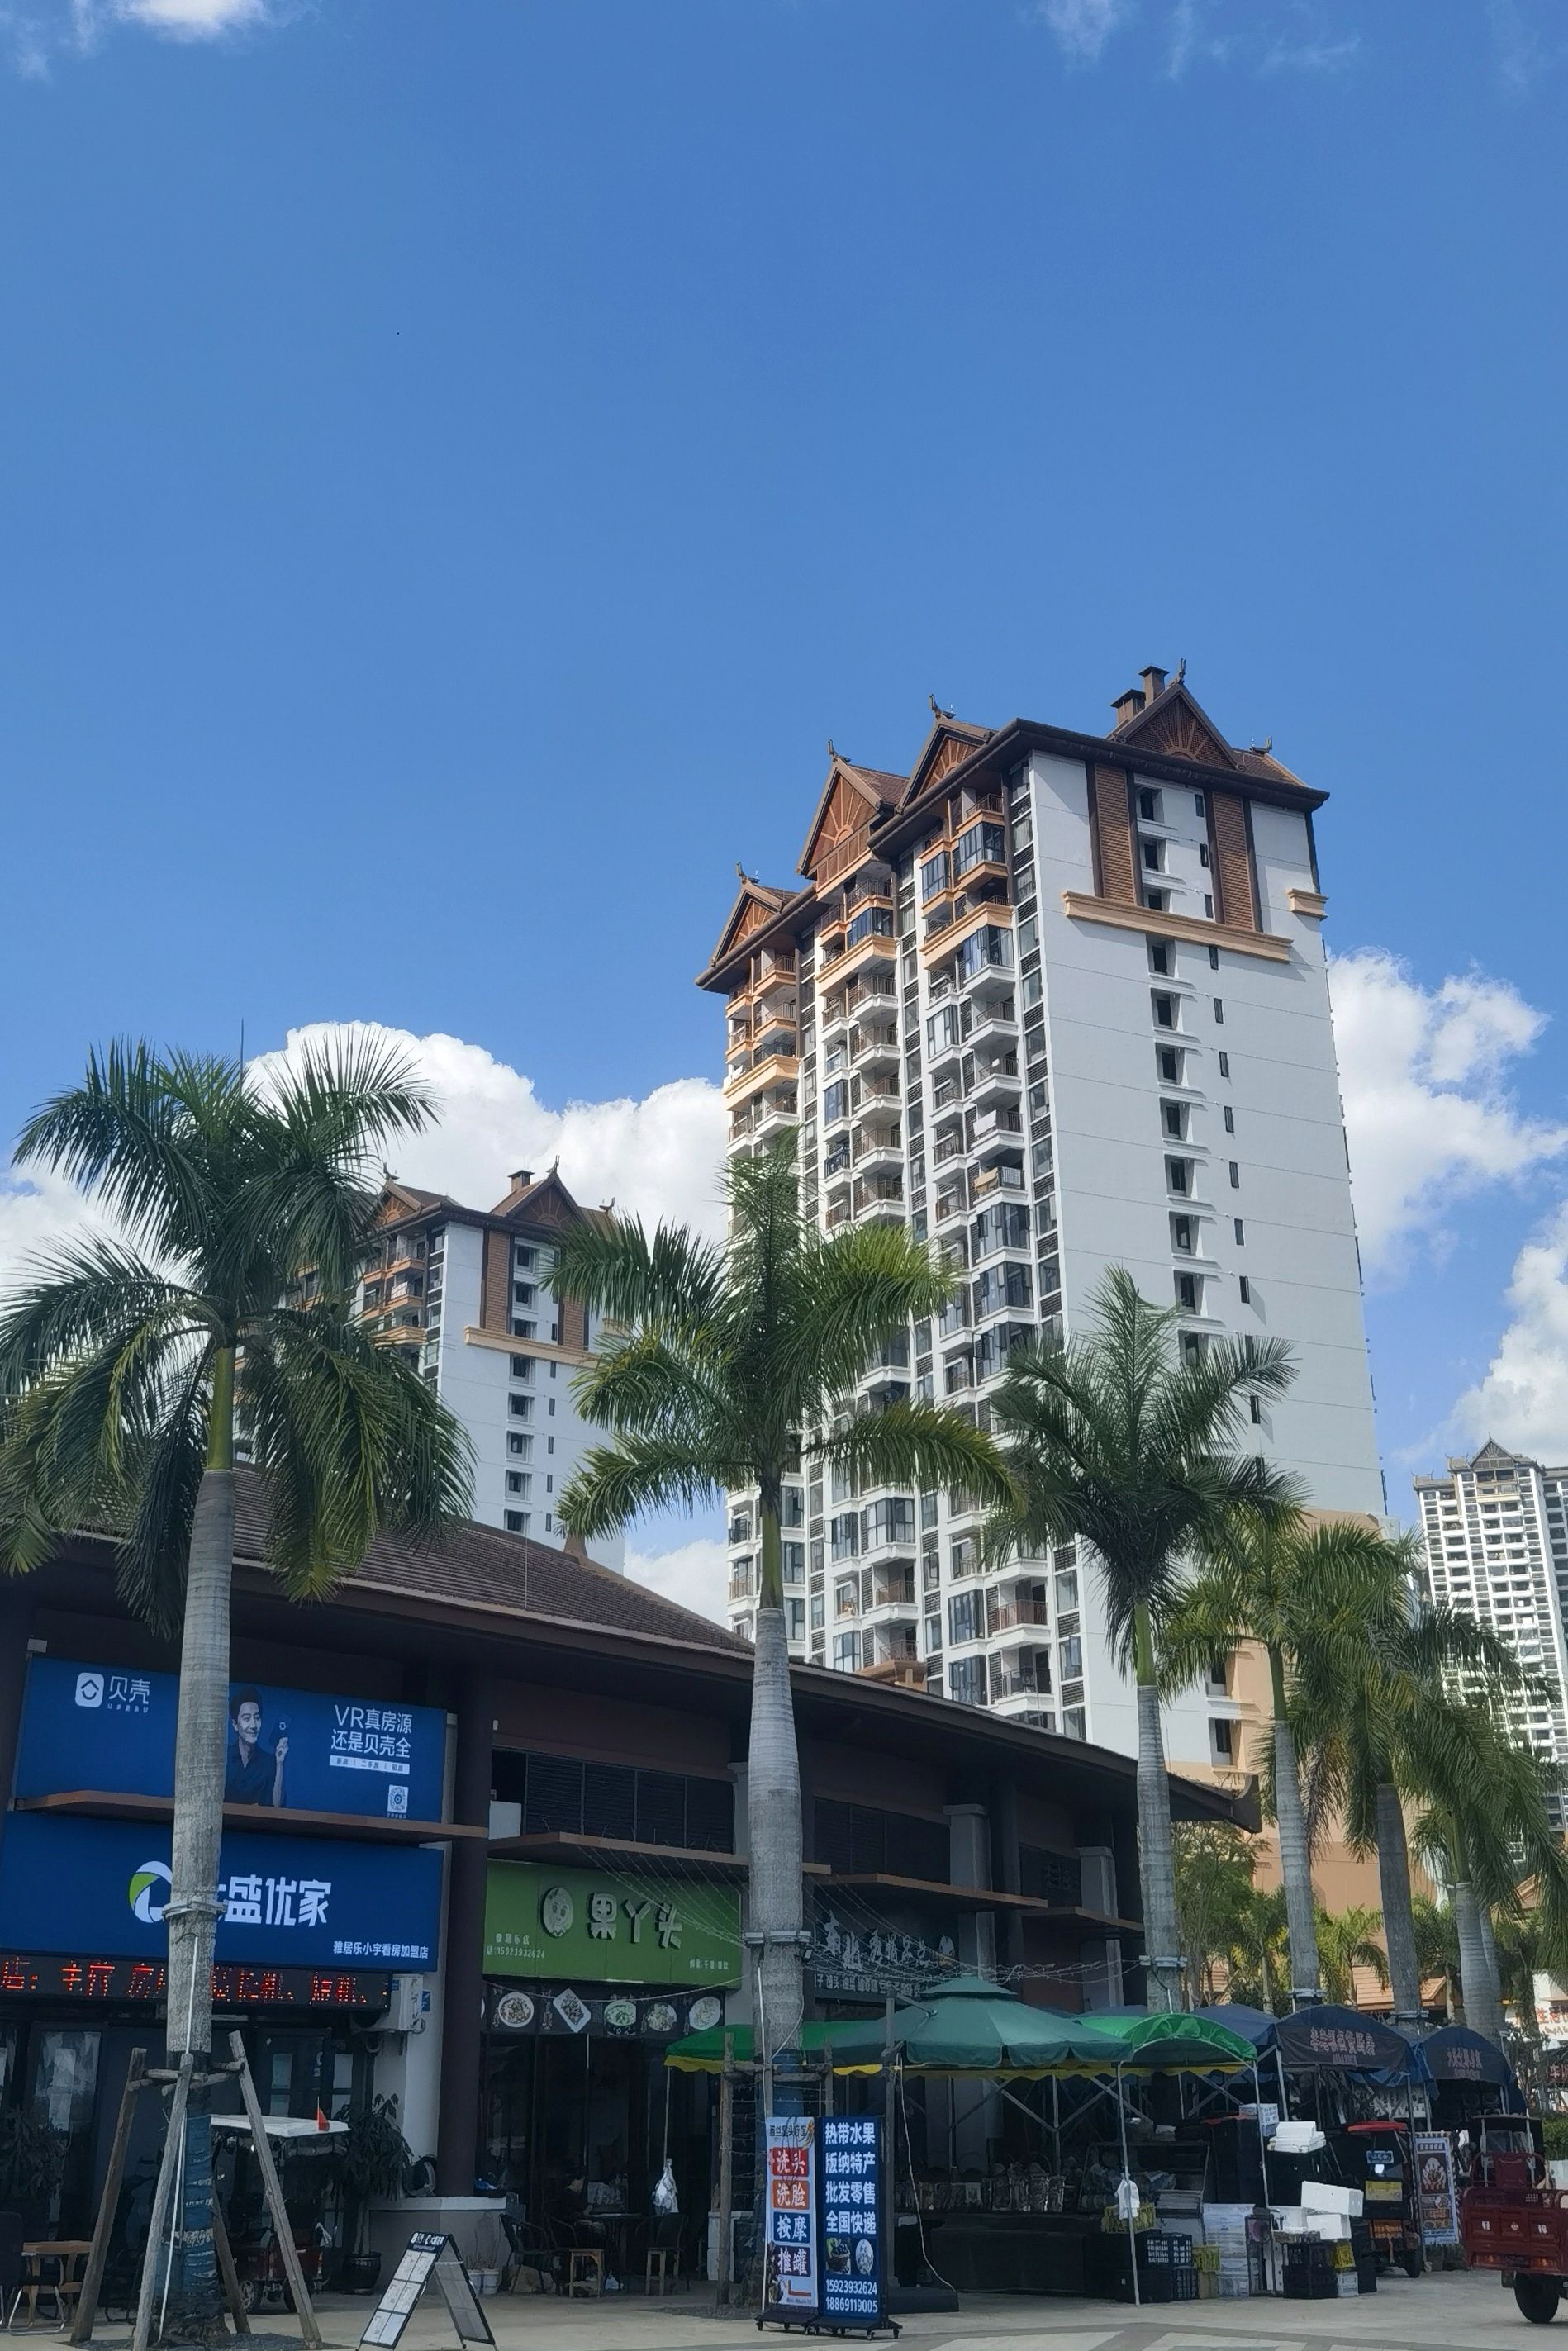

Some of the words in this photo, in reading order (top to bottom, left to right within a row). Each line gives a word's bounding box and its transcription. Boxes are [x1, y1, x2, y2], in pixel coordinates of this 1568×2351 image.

[108, 1675, 150, 1704] 贝壳
[335, 1704, 413, 1734] VR真房源
[330, 1728, 411, 1758] 还是贝壳全
[218, 1874, 332, 1926] 盛优家
[588, 1892, 683, 1950] 果丫头
[824, 2122, 876, 2145] 热带水果
[776, 2149, 806, 2174] 洗头
[825, 2151, 876, 2174] 版纳特产
[776, 2182, 806, 2207] 洗脸
[825, 2181, 876, 2205] 批发零售
[776, 2214, 807, 2241] 按摩
[826, 2210, 877, 2235] 全国快递
[777, 2247, 808, 2276] 推罐
[825, 2279, 877, 2296] 15923932624
[825, 2296, 878, 2313] 18869119005
